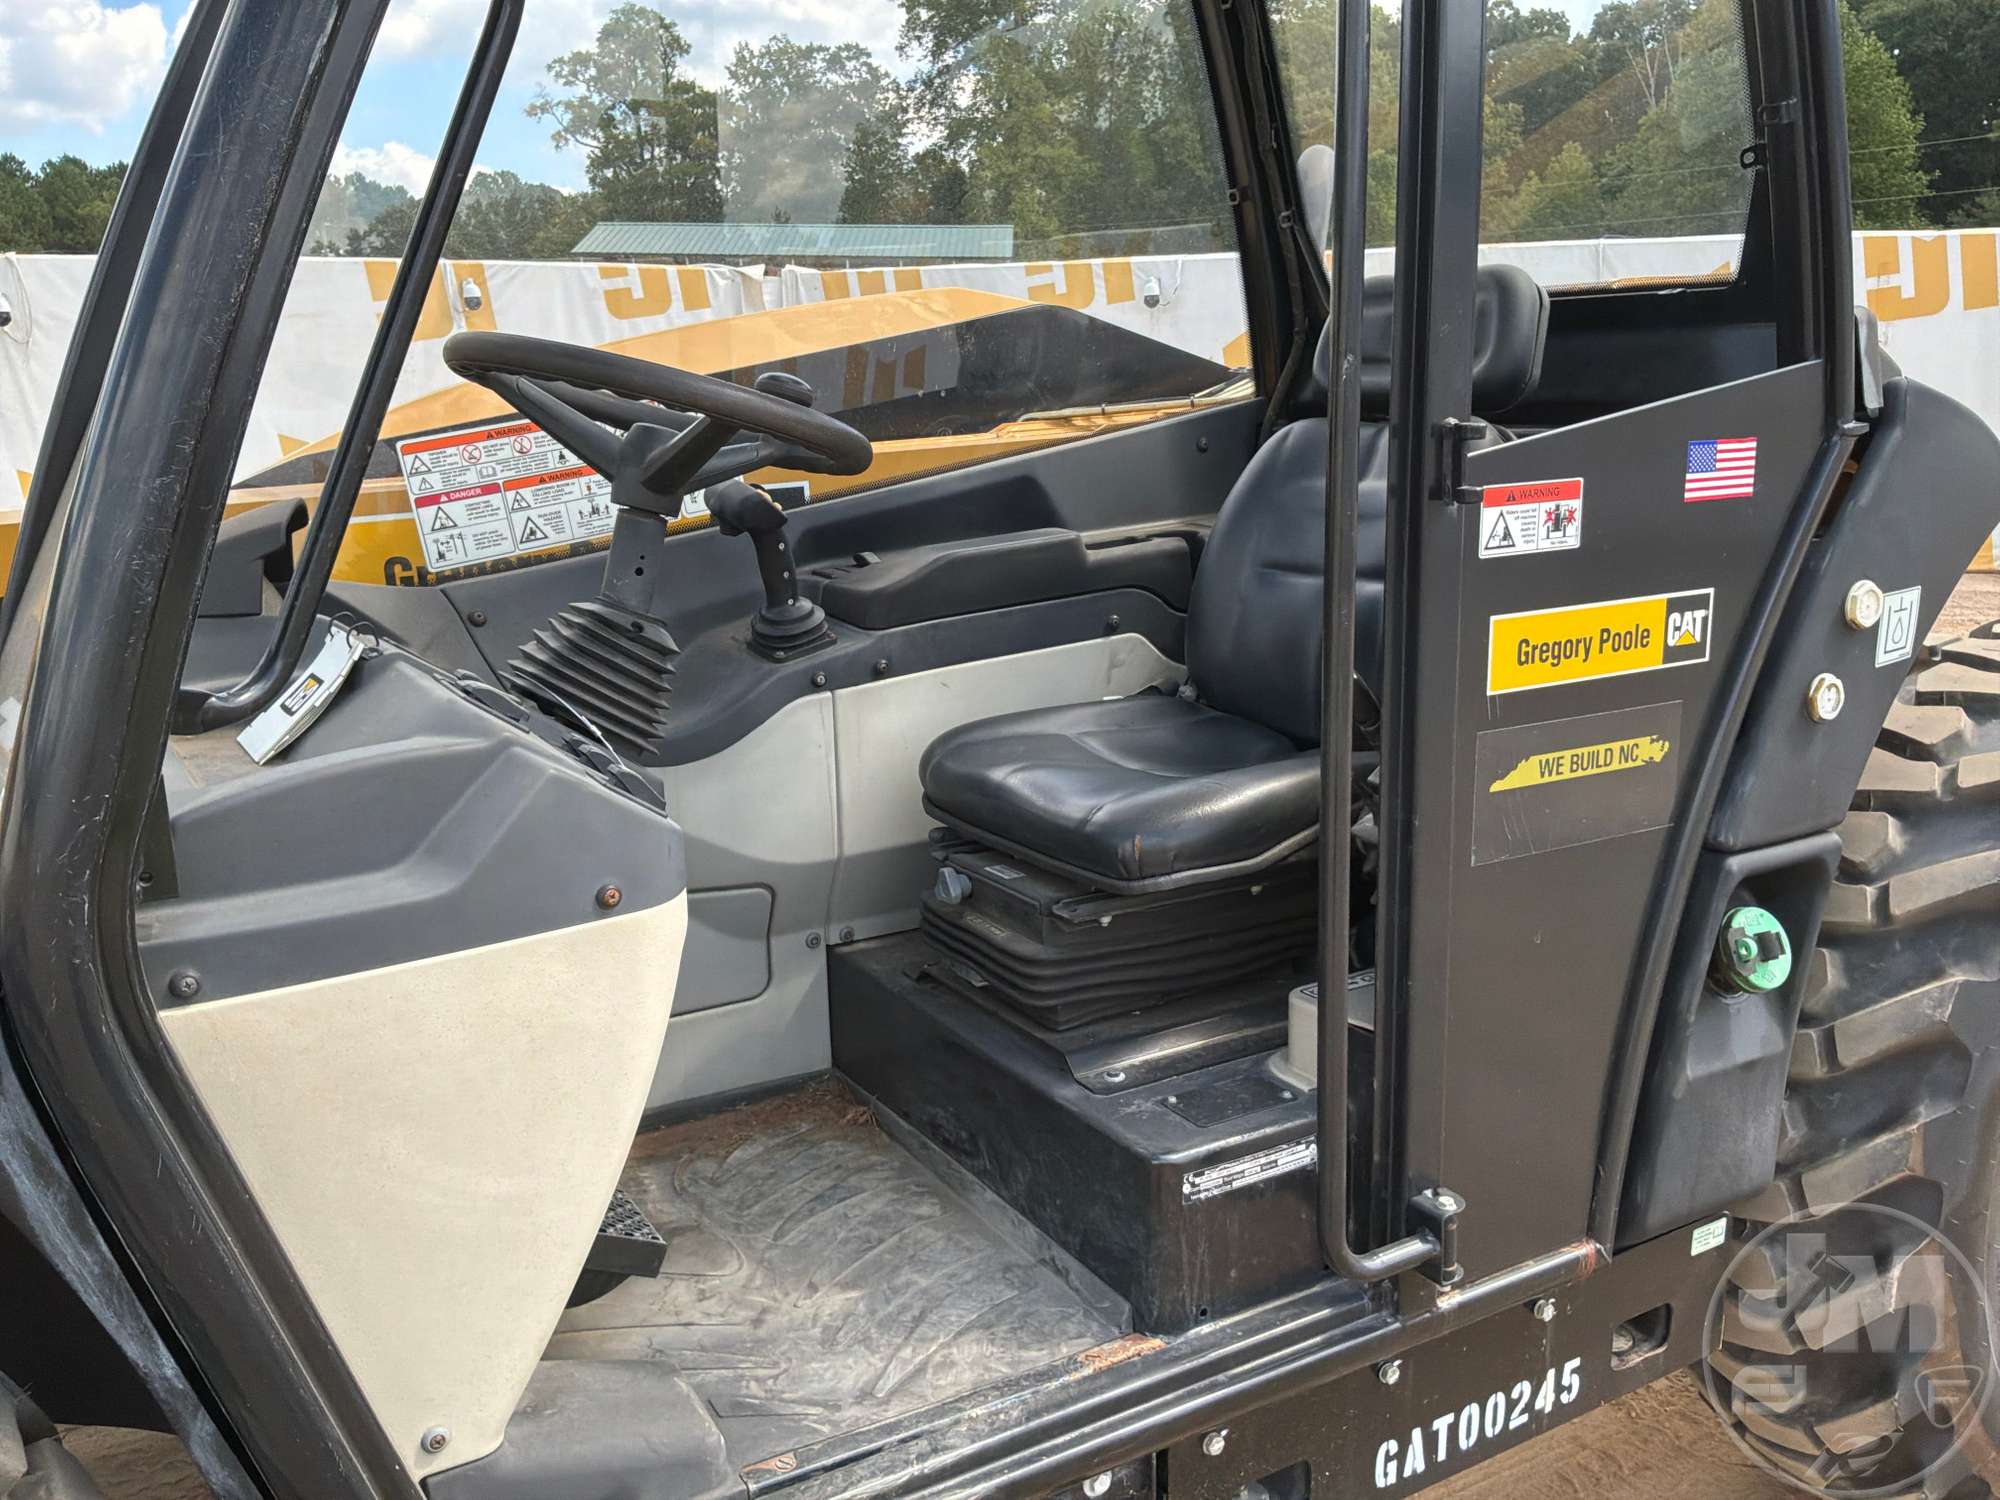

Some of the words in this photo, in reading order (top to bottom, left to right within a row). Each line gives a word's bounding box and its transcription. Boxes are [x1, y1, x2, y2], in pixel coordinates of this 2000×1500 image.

[494, 425, 532, 437] WARNING
[548, 470, 584, 481] WARNING
[449, 487, 482, 500] DANGER
[1519, 487, 1560, 500] WARNING
[1517, 632, 1593, 669] Gregory
[1598, 624, 1651, 656] Poole
[1667, 609, 1705, 647] CAT
[1538, 756, 1565, 779] WE
[1569, 747, 1614, 774] BUILD
[1618, 742, 1640, 765] NC
[1374, 1356, 1583, 1490] GAT00245
